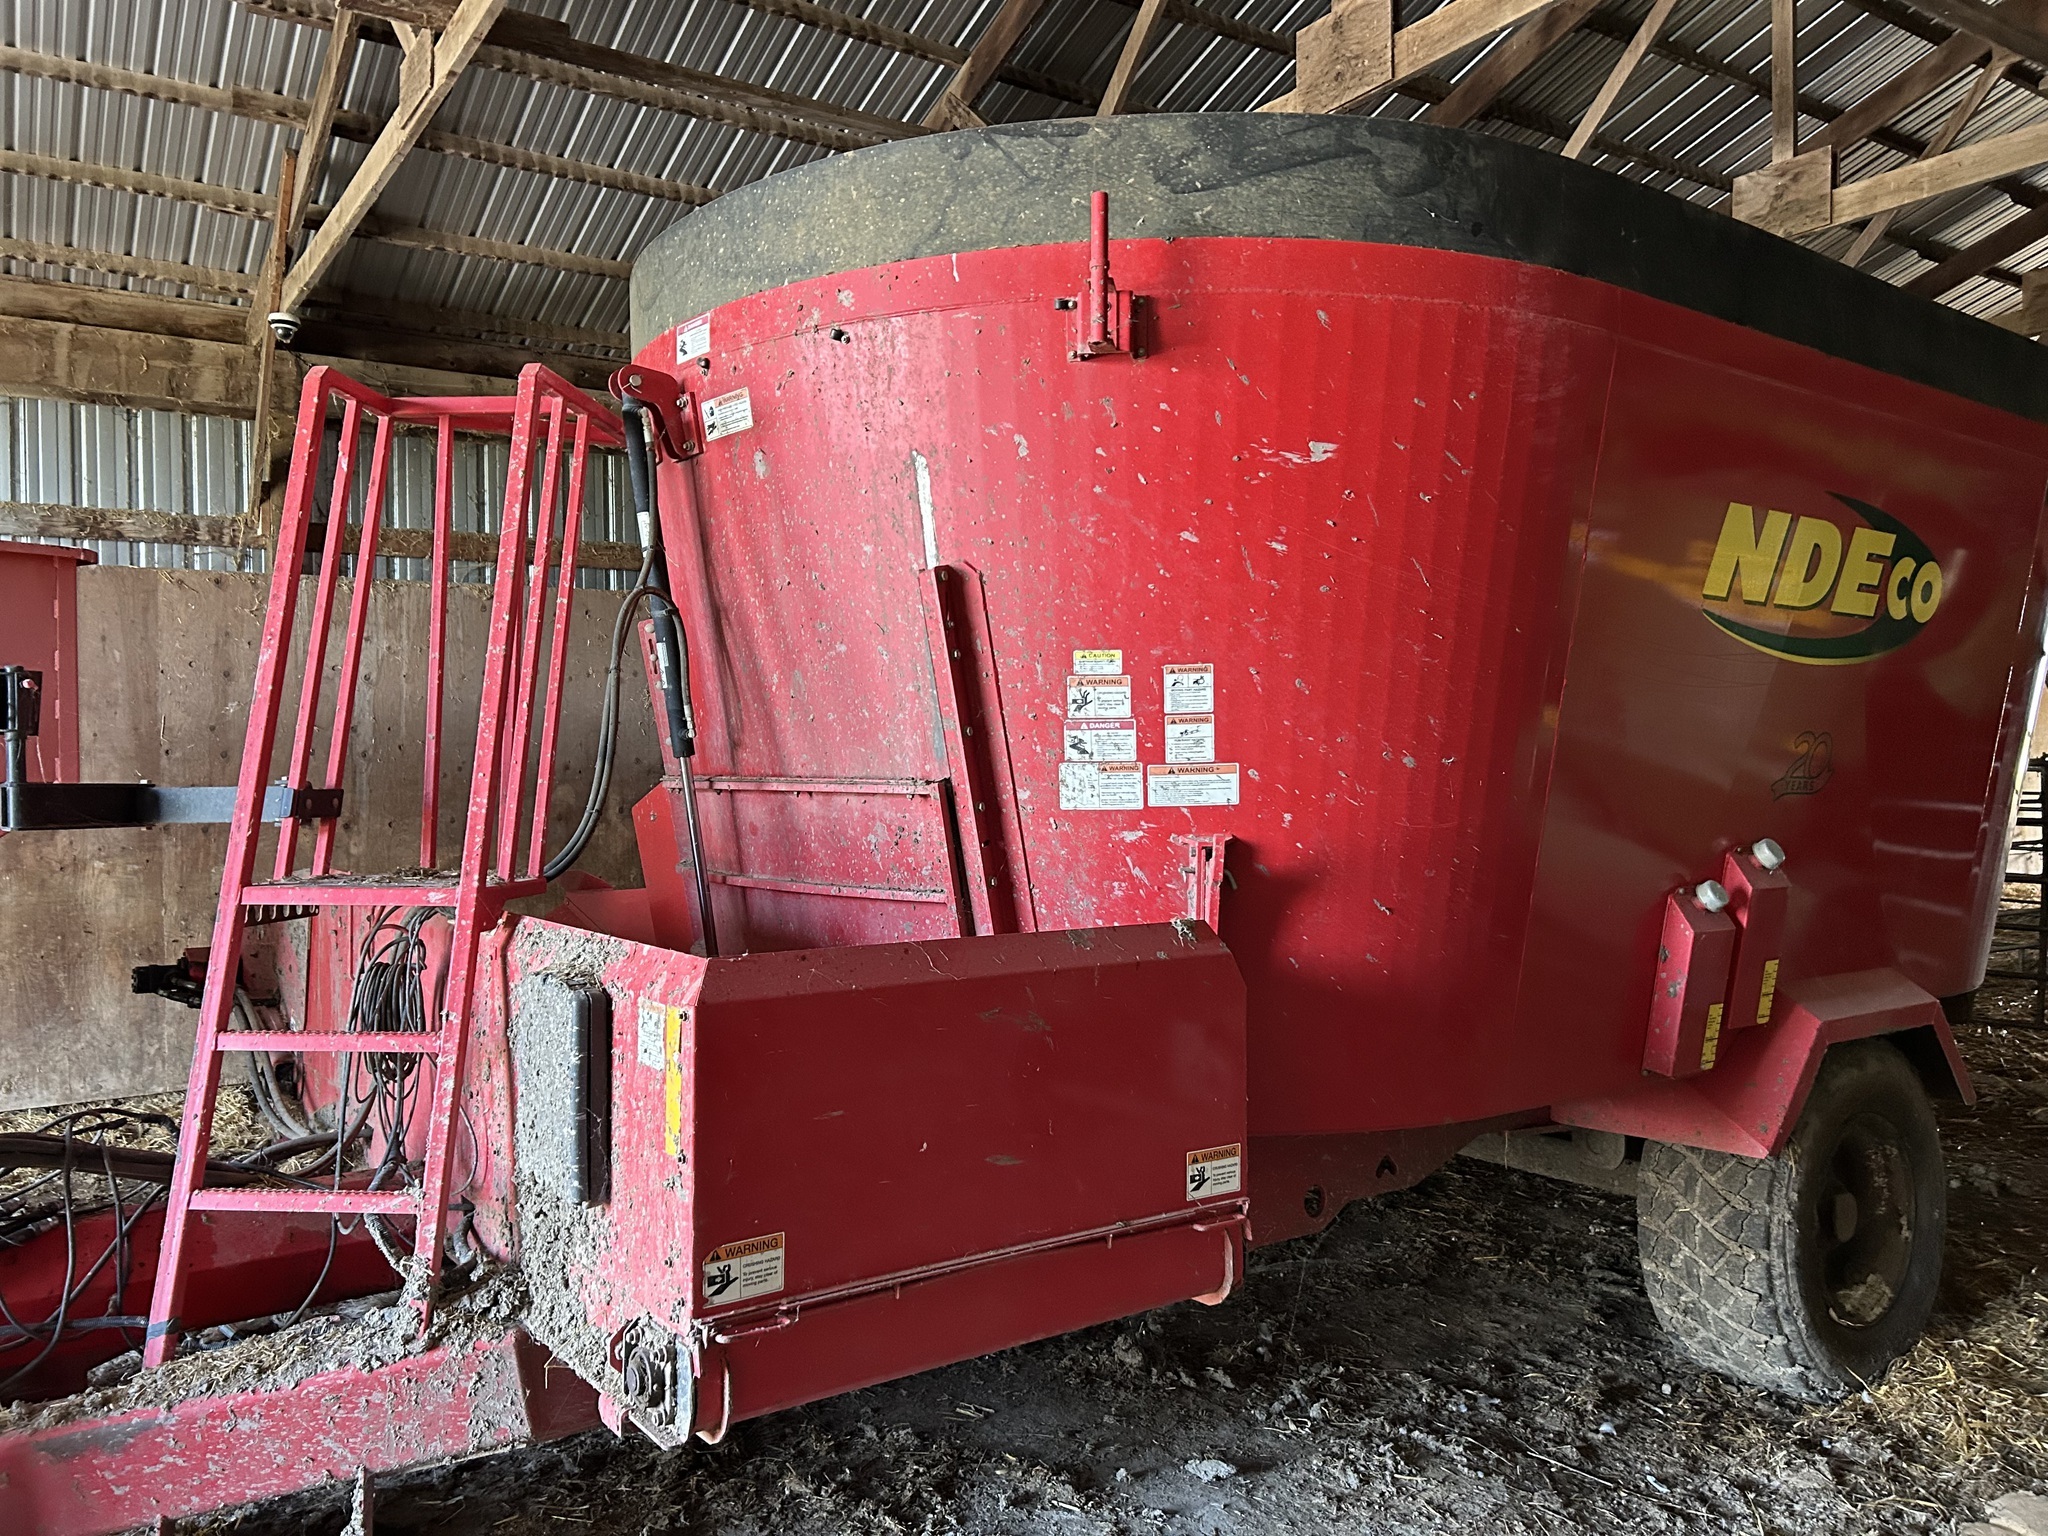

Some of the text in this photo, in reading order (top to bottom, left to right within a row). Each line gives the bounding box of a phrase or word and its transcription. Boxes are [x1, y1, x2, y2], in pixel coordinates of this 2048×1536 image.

[1085, 678, 1123, 686] WARNING
[1177, 766, 1215, 774] WARNING
[1201, 1148, 1237, 1161] WARNING
[724, 1237, 779, 1258] WARNING
